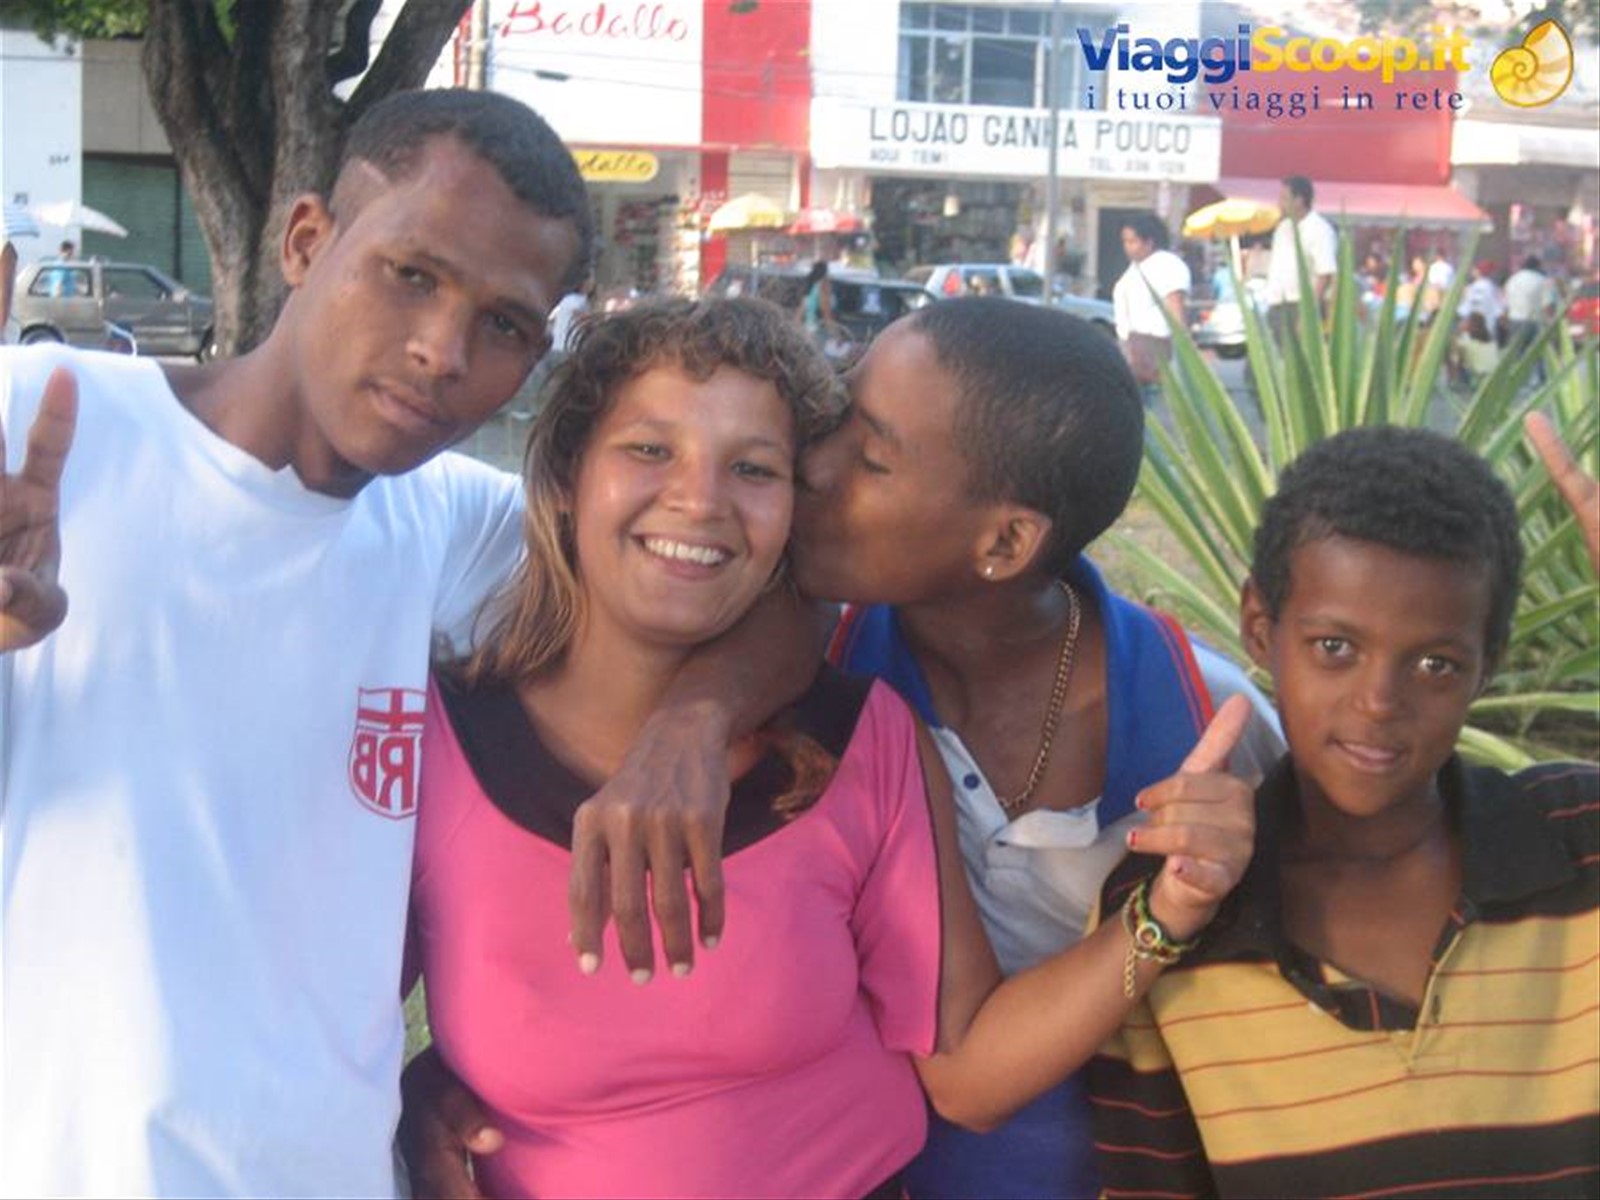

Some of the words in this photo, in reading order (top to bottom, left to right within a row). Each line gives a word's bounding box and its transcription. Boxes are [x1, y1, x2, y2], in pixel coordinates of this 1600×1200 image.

[501, 0, 688, 41] Badallo
[1096, 118, 1191, 154] POUCO
[579, 153, 652, 176] dallo
